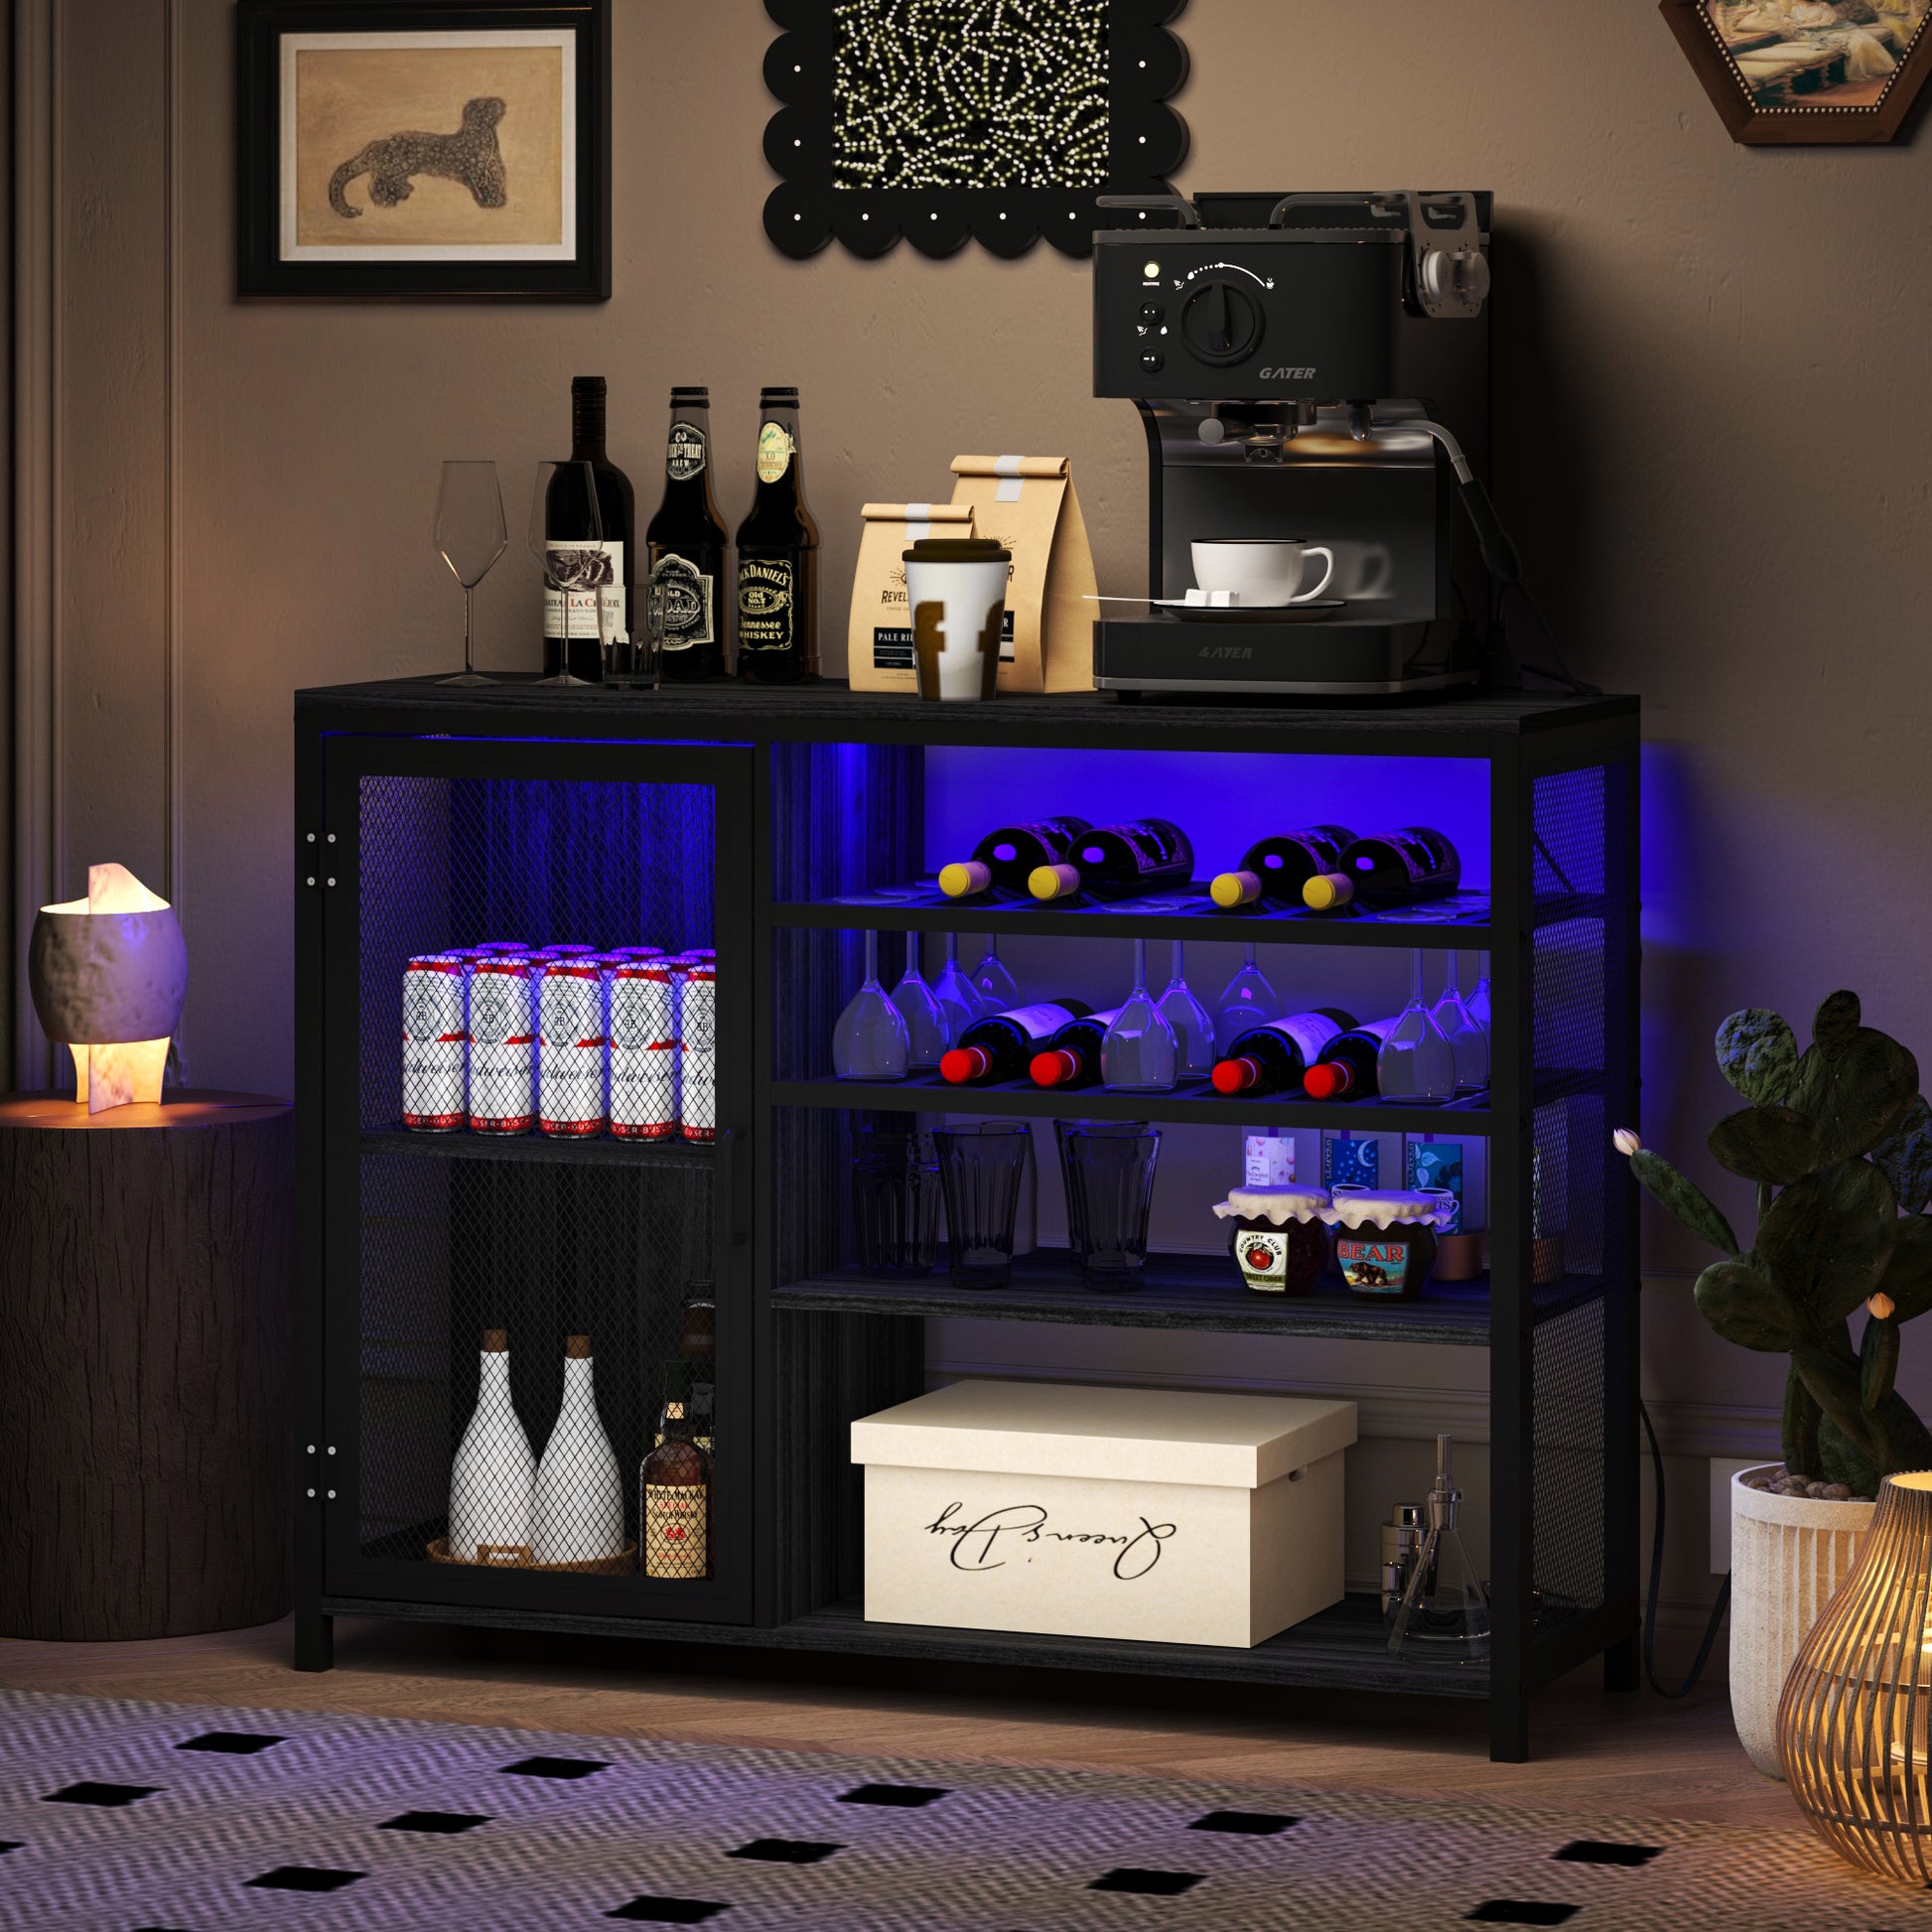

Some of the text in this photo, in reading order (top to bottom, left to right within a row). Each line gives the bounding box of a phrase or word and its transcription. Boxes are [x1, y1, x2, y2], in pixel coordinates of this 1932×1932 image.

[1259, 366, 1316, 379] GATER
[882, 590, 909, 604] REVEL
[878, 632, 898, 642] PALE
[1239, 1235, 1282, 1256] COUNTRY CLUB
[1337, 1241, 1405, 1262] BEAR
